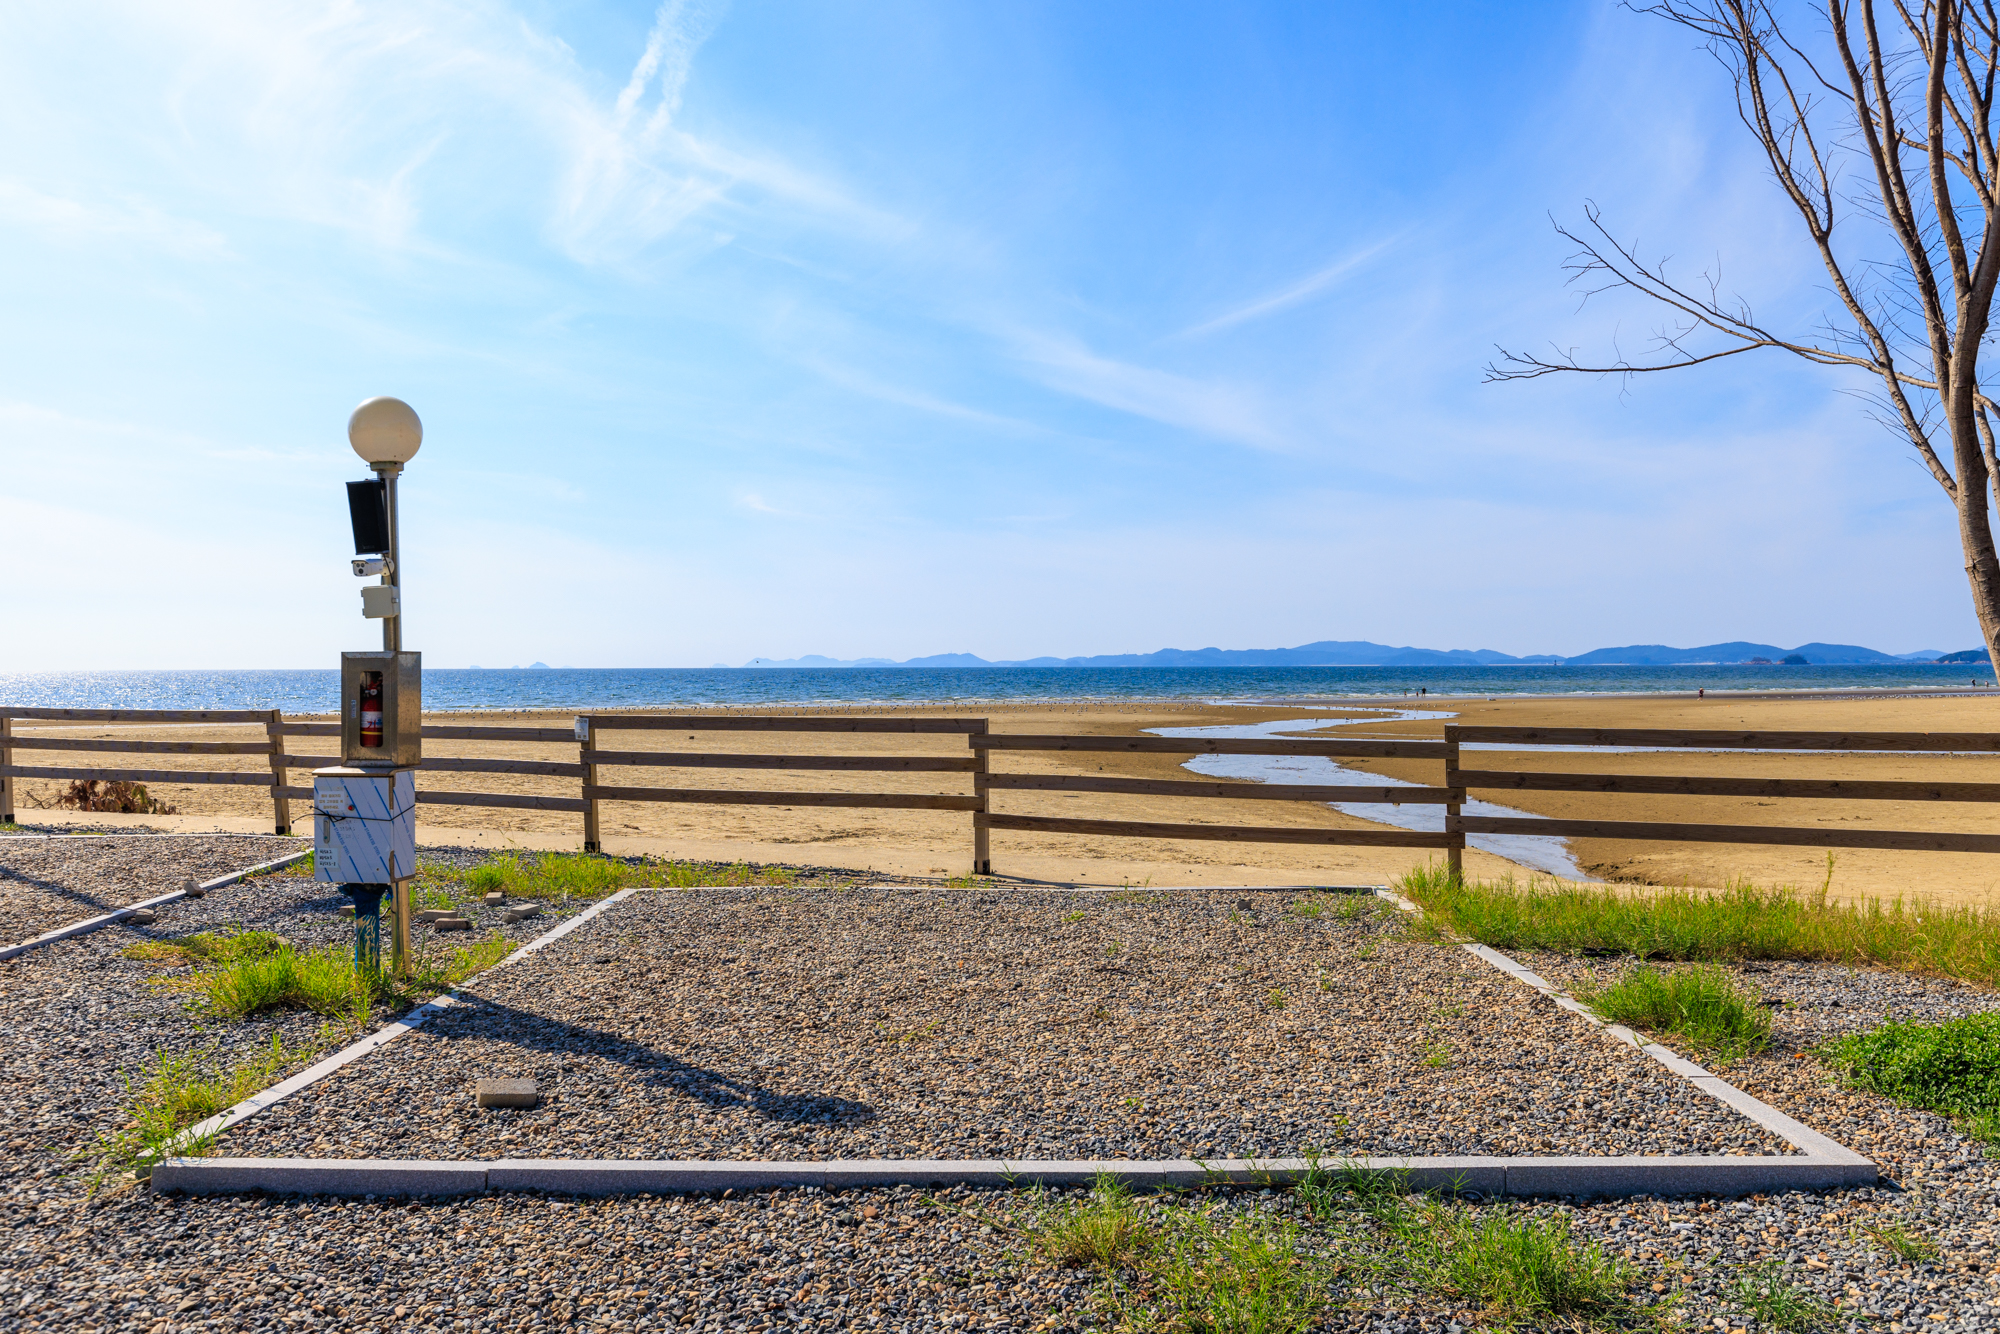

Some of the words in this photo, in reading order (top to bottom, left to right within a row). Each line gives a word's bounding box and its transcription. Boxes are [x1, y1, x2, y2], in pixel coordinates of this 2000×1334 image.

[334, 827, 345, 846] STAINLESS
[364, 827, 376, 846] STAINLESS
[373, 845, 381, 857] STEEL
